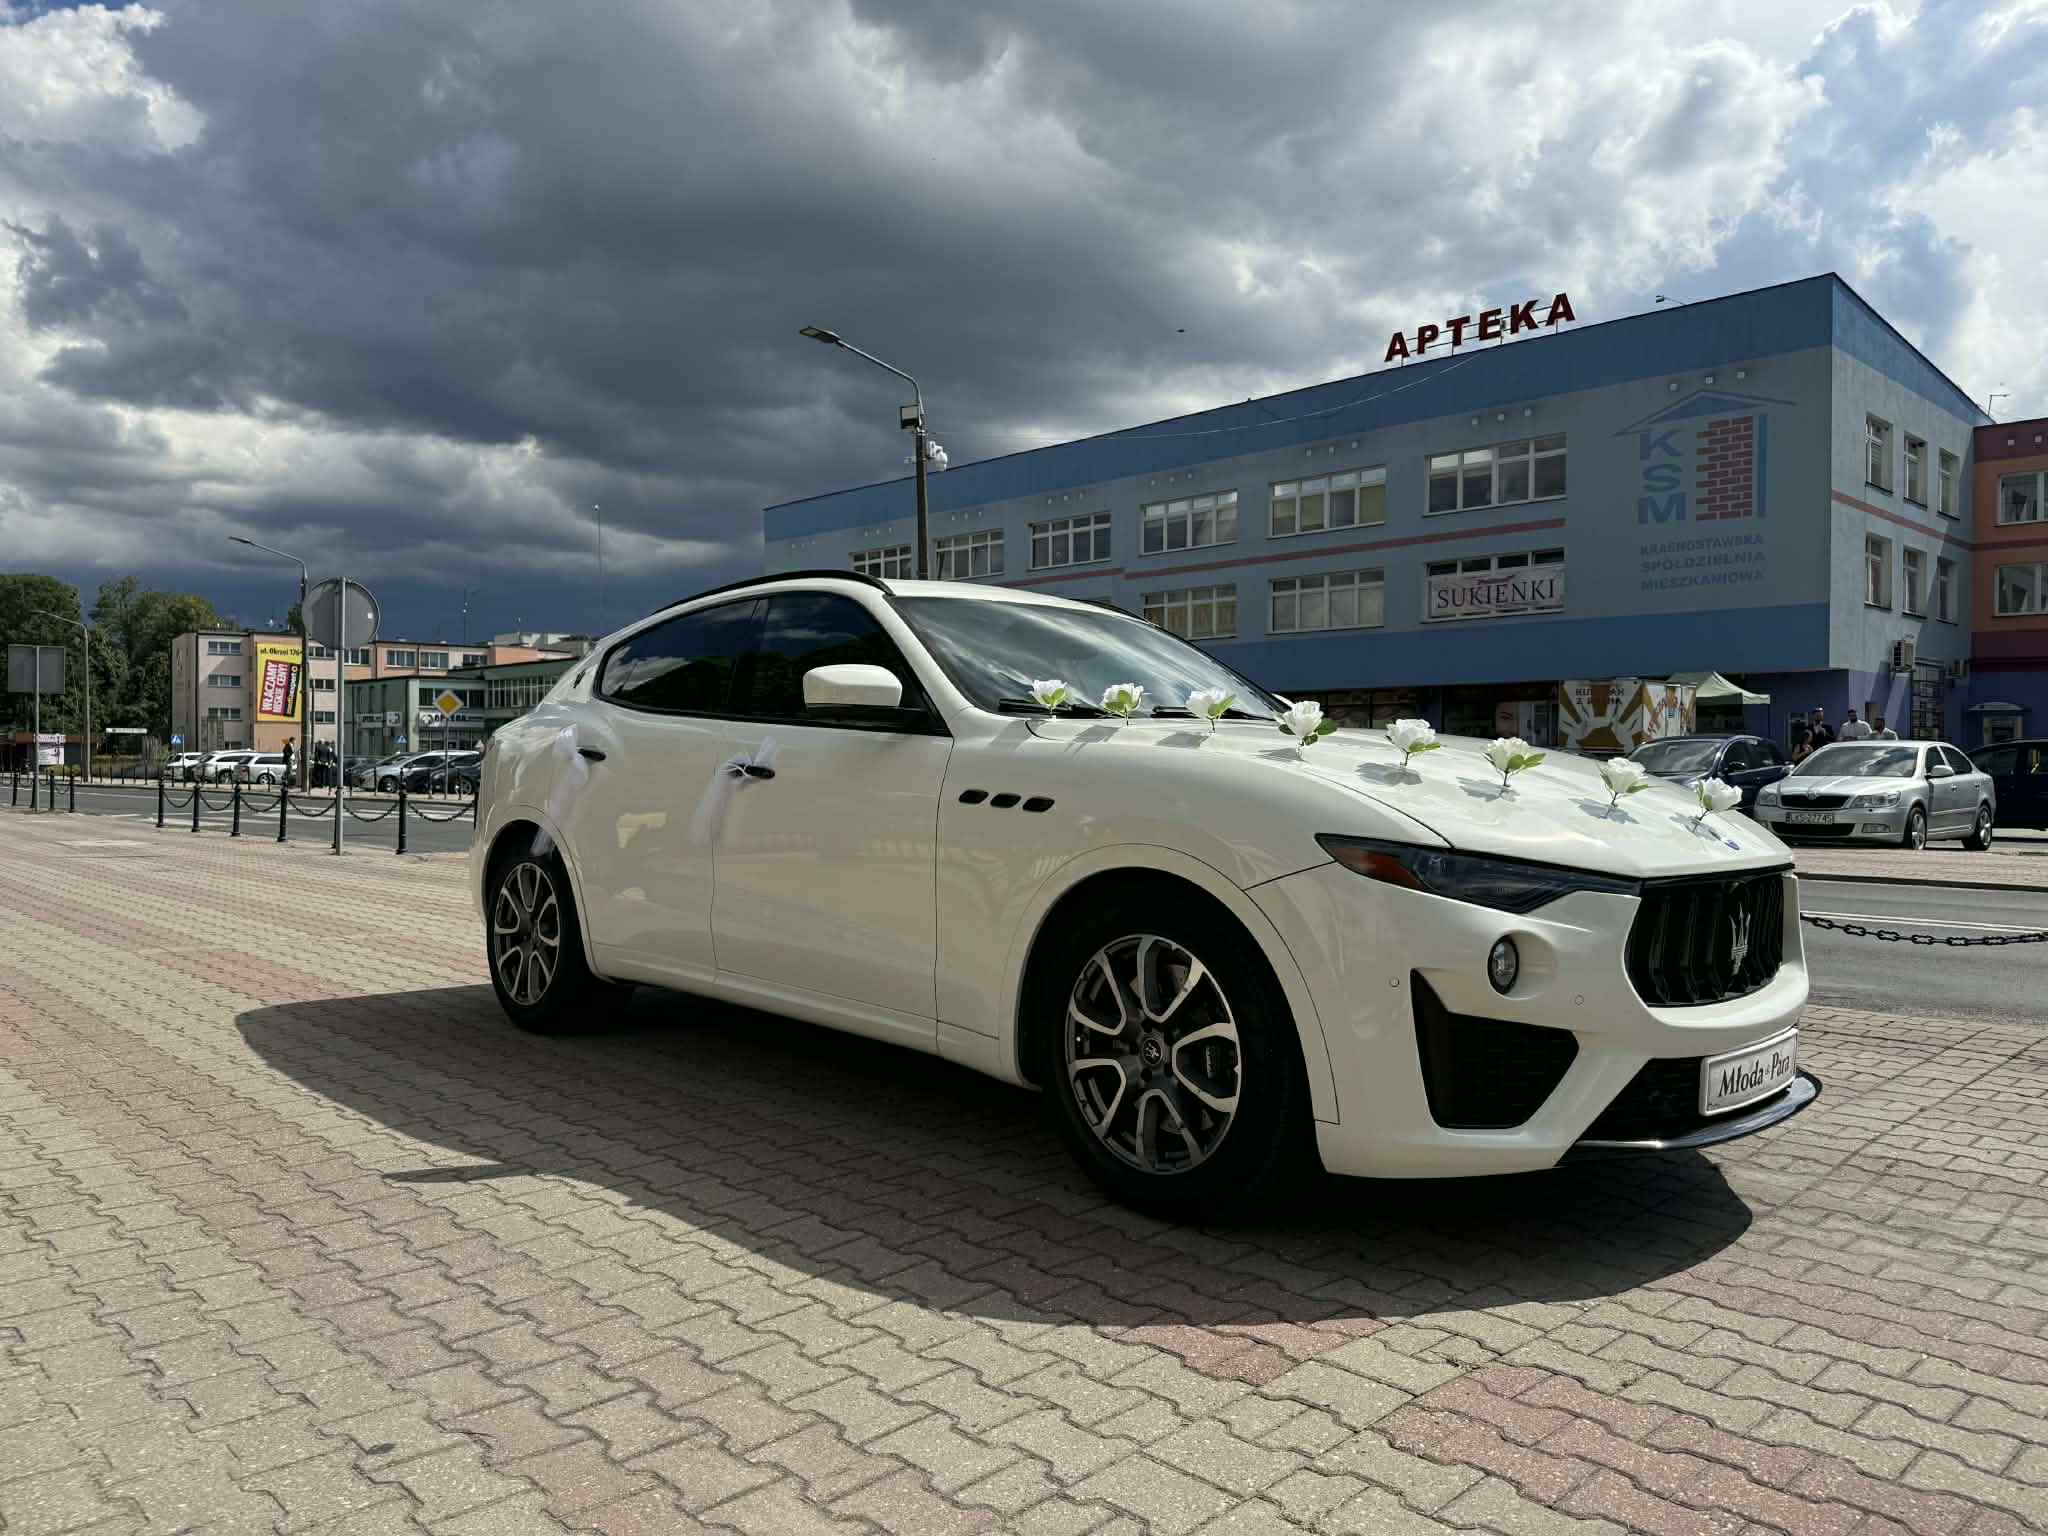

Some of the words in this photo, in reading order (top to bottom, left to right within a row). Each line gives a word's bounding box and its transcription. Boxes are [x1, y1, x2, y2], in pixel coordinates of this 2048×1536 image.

[1384, 293, 1576, 362] APTEKA
[1438, 578, 1556, 609] SUKIENKI
[1718, 1059, 1764, 1098] Młoda
[1771, 1051, 1790, 1081] Para
